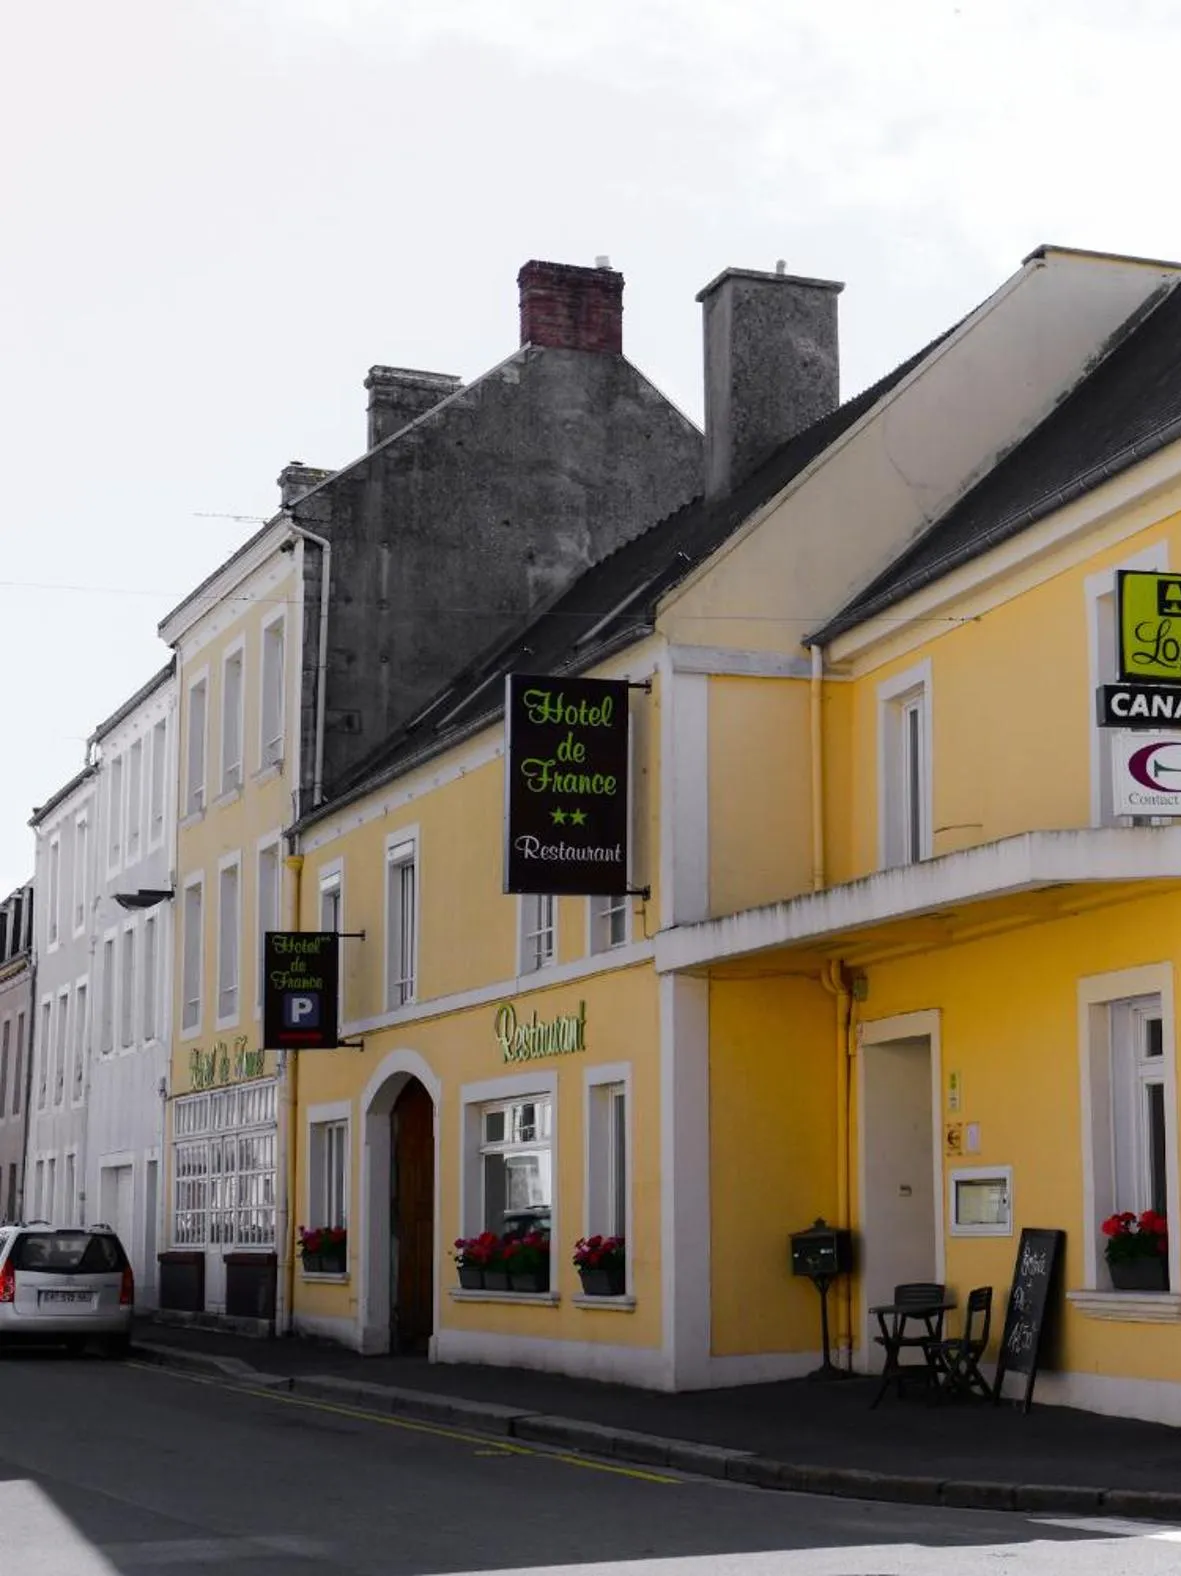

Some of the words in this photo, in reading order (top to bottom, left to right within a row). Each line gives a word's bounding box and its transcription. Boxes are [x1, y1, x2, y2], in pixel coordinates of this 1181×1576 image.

[523, 688, 614, 728] Hotel
[556, 731, 586, 763] de
[520, 757, 617, 796] France
[1128, 792, 1180, 806] Contact
[514, 834, 624, 863] Restaurant
[291, 998, 313, 1023] P
[494, 1000, 587, 1064] Restaurant
